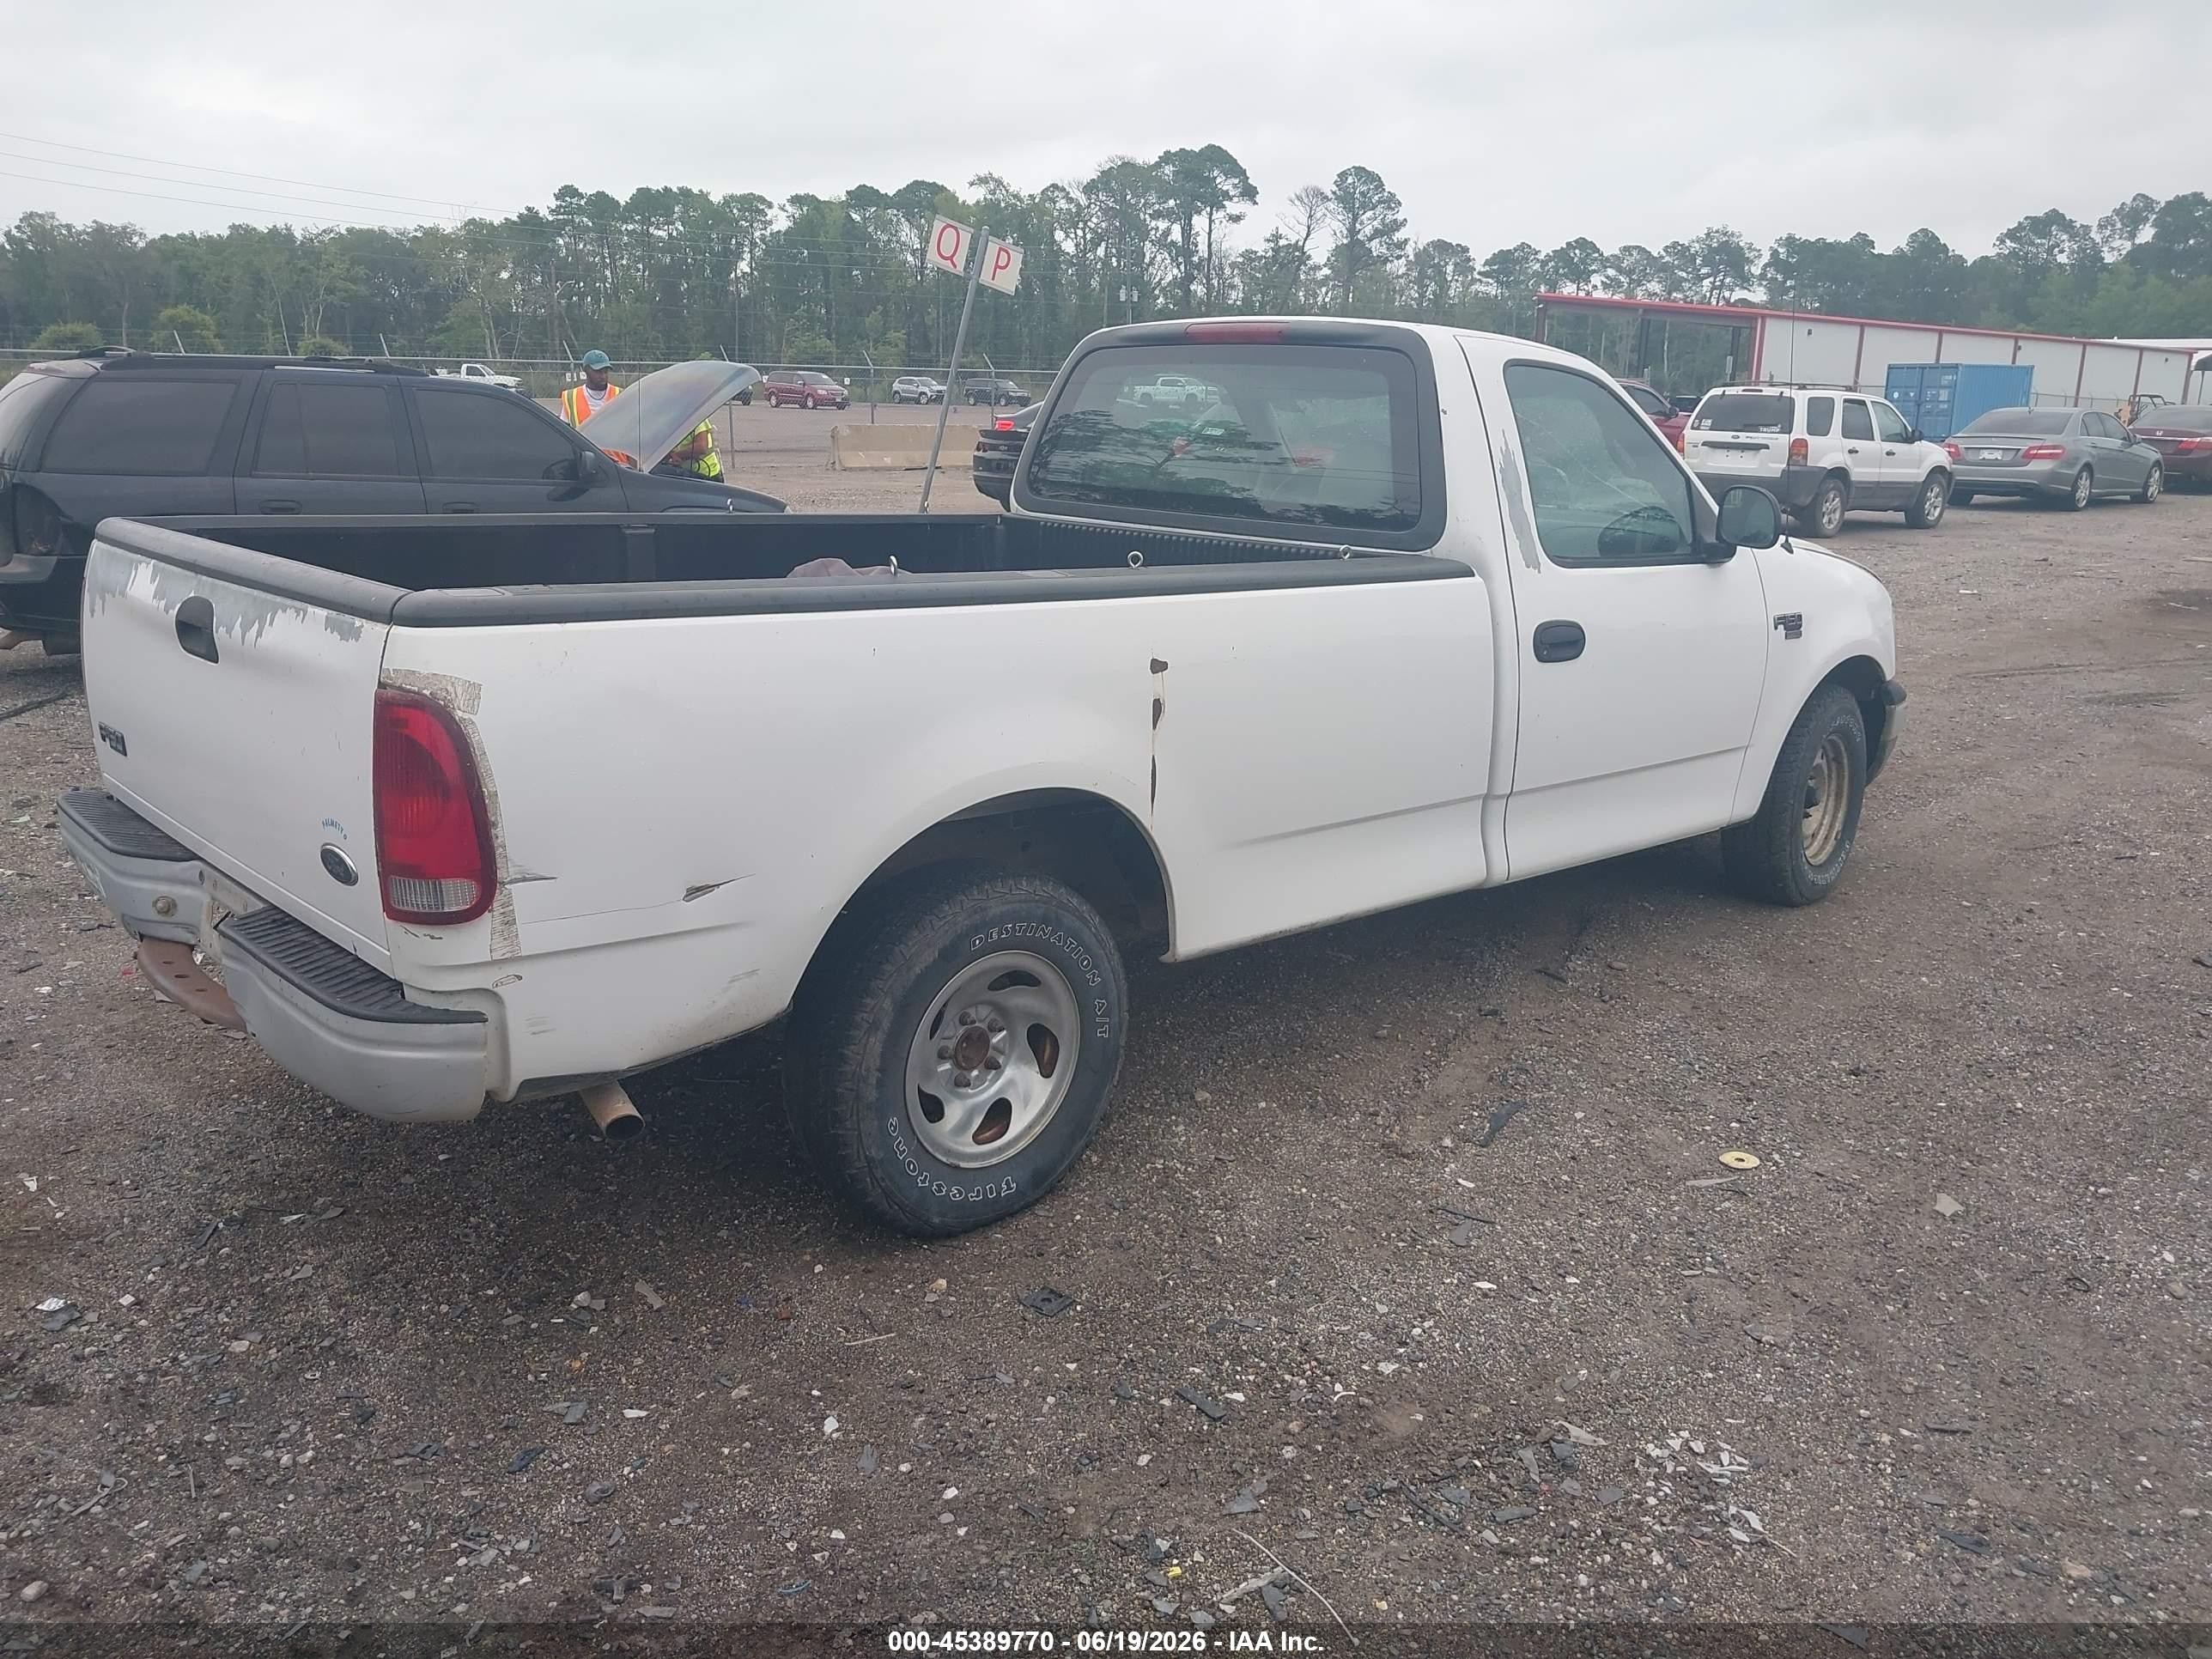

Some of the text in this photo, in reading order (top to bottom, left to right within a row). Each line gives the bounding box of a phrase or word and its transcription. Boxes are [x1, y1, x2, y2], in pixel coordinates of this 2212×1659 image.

[936, 222, 961, 270] Q
[991, 246, 1012, 282] P
[970, 922, 1102, 987] DESTINATION
[887, 1116, 1017, 1198] Firestone
